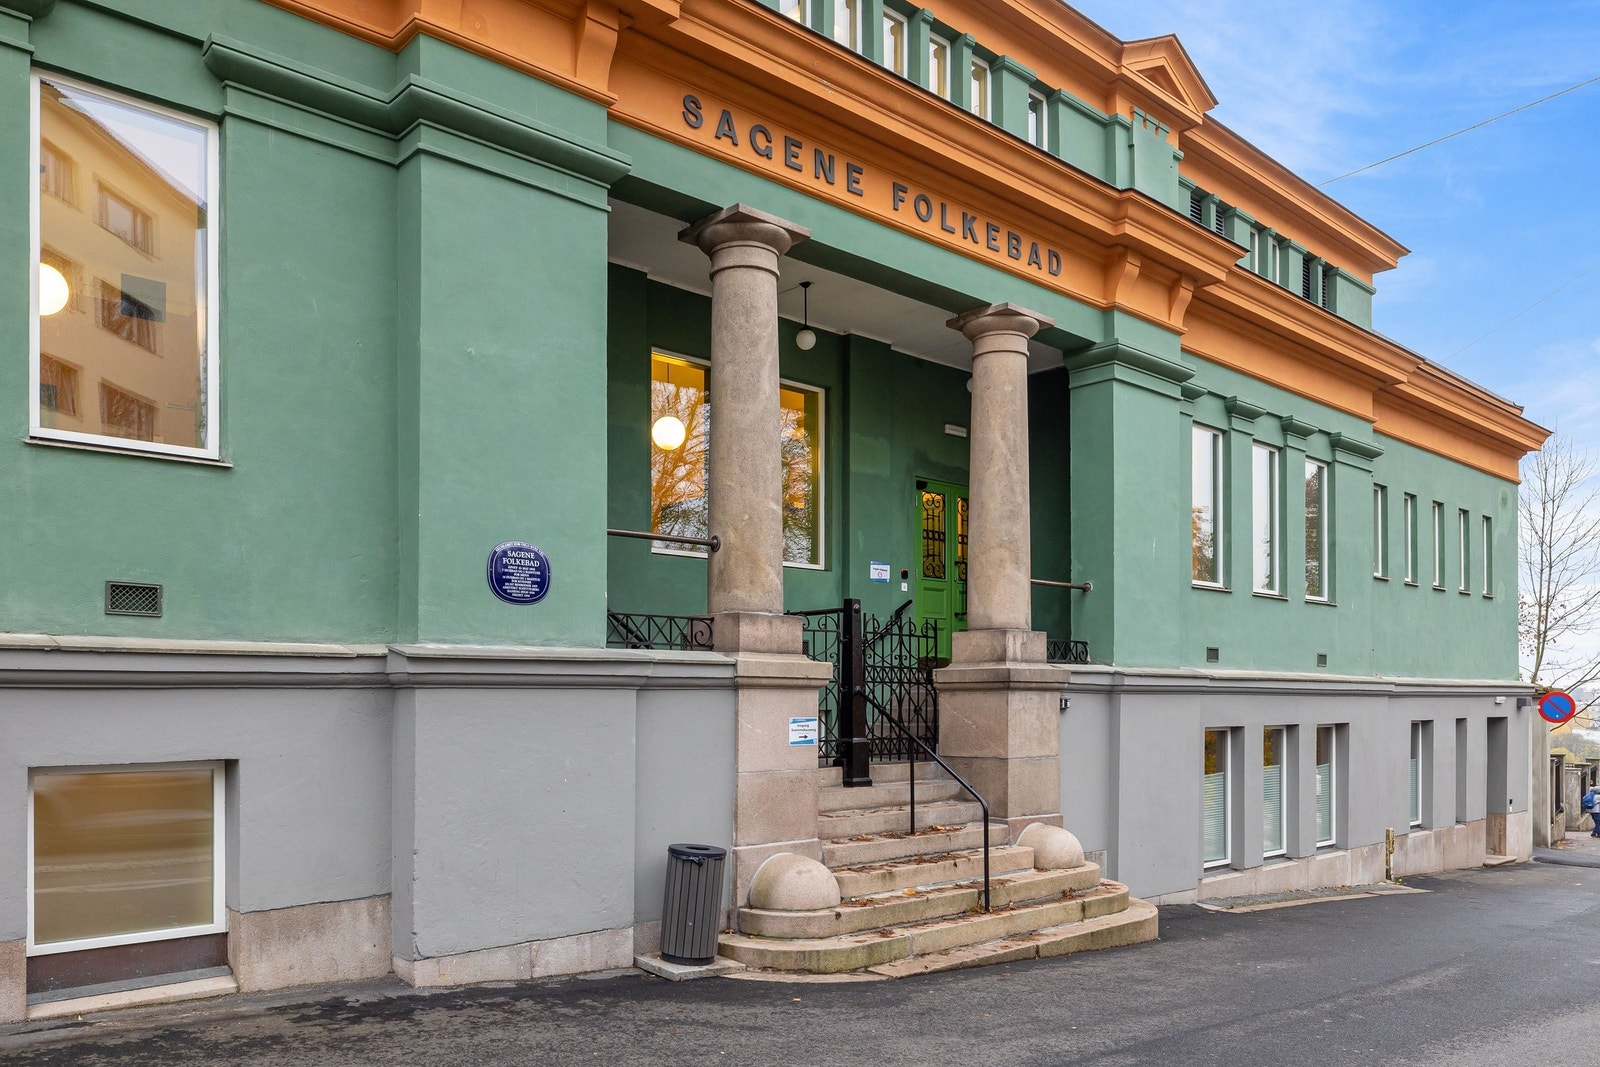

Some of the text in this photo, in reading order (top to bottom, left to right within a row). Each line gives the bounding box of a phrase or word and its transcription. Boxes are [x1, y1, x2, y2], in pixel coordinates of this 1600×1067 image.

[682, 94, 1062, 276] SAGENE FOLKEBAD
[507, 550, 535, 559] SAGENE
[502, 557, 540, 567] FOLKEBAD
